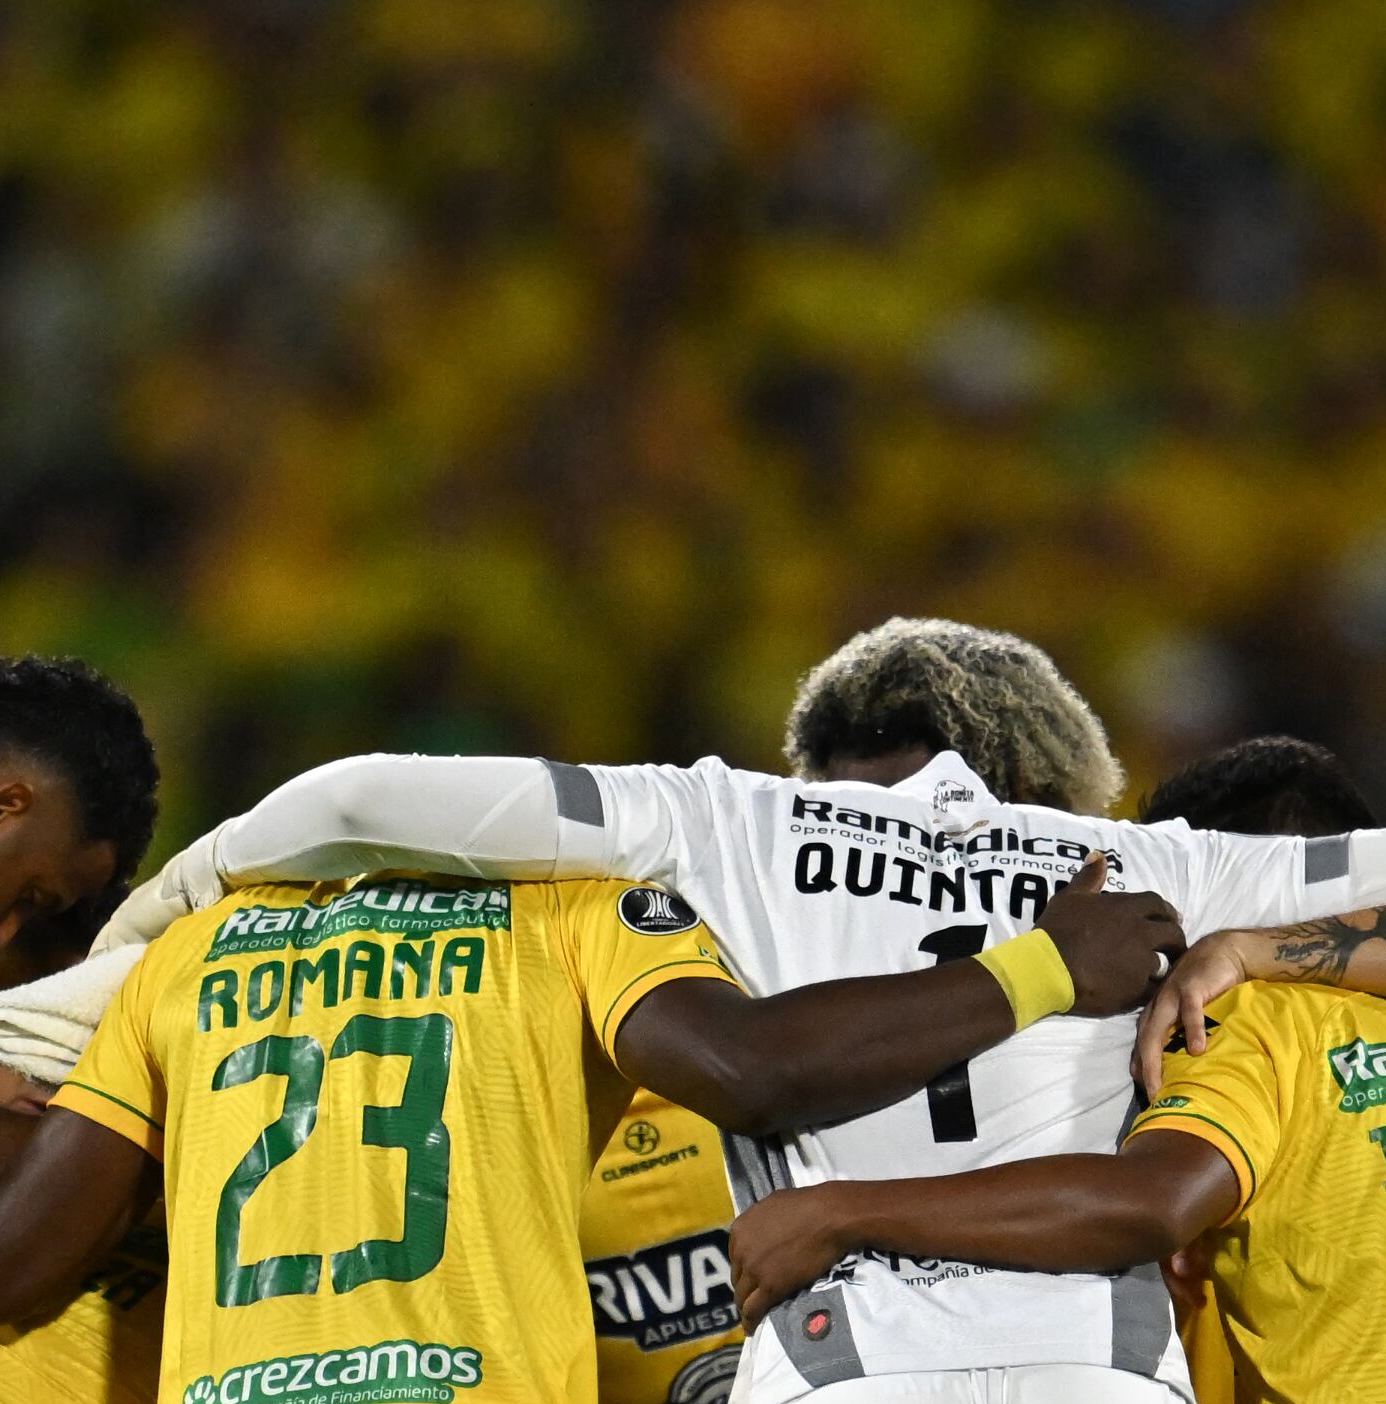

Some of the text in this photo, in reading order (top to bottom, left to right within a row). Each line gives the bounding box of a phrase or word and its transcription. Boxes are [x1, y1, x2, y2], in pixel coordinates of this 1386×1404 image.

[794, 841, 1070, 924] QUINTA
[197, 931, 485, 1033] ROMAÑA
[212, 1013, 452, 1307] 23
[586, 1244, 735, 1324] RIVA
[644, 1304, 740, 1346] APUEST
